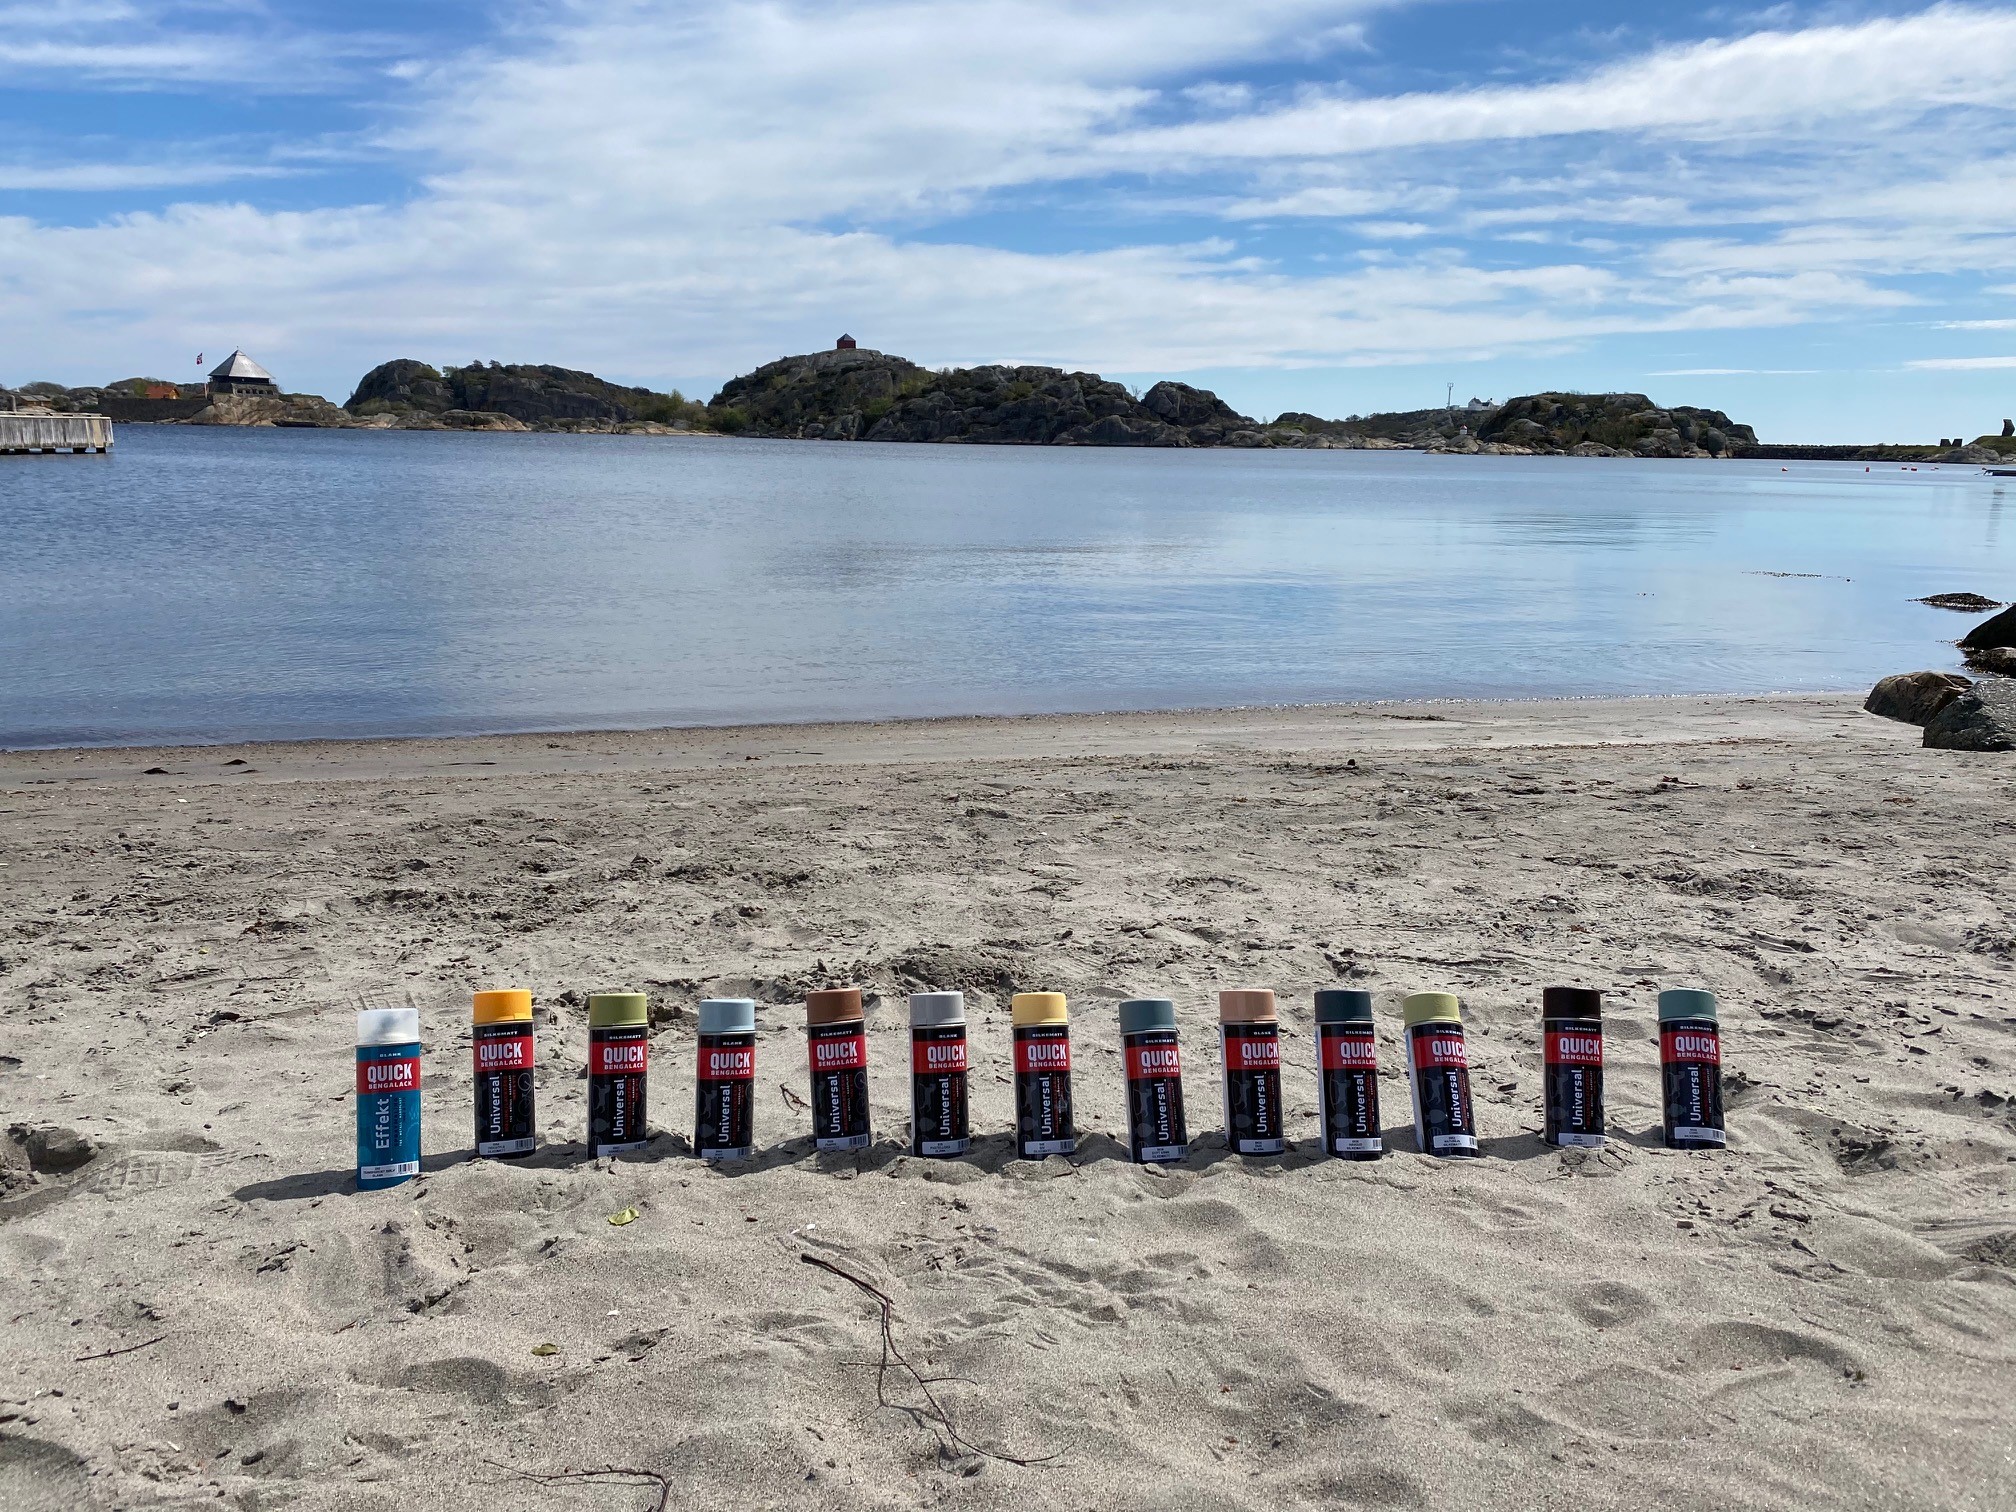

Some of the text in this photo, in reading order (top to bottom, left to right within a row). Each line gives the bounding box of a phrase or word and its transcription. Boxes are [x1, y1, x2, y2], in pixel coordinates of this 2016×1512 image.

[480, 1042, 522, 1062] QUICK
[603, 1045, 644, 1064] QUICK
[817, 1041, 857, 1061] QUICK
[927, 1045, 964, 1063] QUICK
[1027, 1044, 1066, 1061] QUICK
[1560, 1038, 1600, 1054] QUICK
[1675, 1036, 1717, 1054] QUICK
[481, 1059, 522, 1067] BENGALACK
[710, 1052, 750, 1069] QUICK
[818, 1058, 857, 1067] BENGALACK
[929, 1061, 965, 1069] BENGALACK
[1141, 1050, 1178, 1067] QUICK
[1677, 1052, 1717, 1060] BENGALACK
[367, 1063, 412, 1083] QUICK
[369, 1081, 412, 1089] BENGALACK
[1688, 1067, 1701, 1121] Universal
[490, 1075, 501, 1134] Universal
[613, 1079, 624, 1136] Universal
[828, 1075, 840, 1133] Universal
[939, 1078, 950, 1136] Universal
[1039, 1077, 1051, 1135] Universal
[1254, 1075, 1267, 1132] Universal
[1354, 1075, 1366, 1132] Universal
[1446, 1071, 1462, 1126] Universal
[1571, 1069, 1582, 1126] Universal
[719, 1085, 730, 1142] Universal
[1154, 1083, 1169, 1141] Universal
[375, 1099, 389, 1149] Effekt
